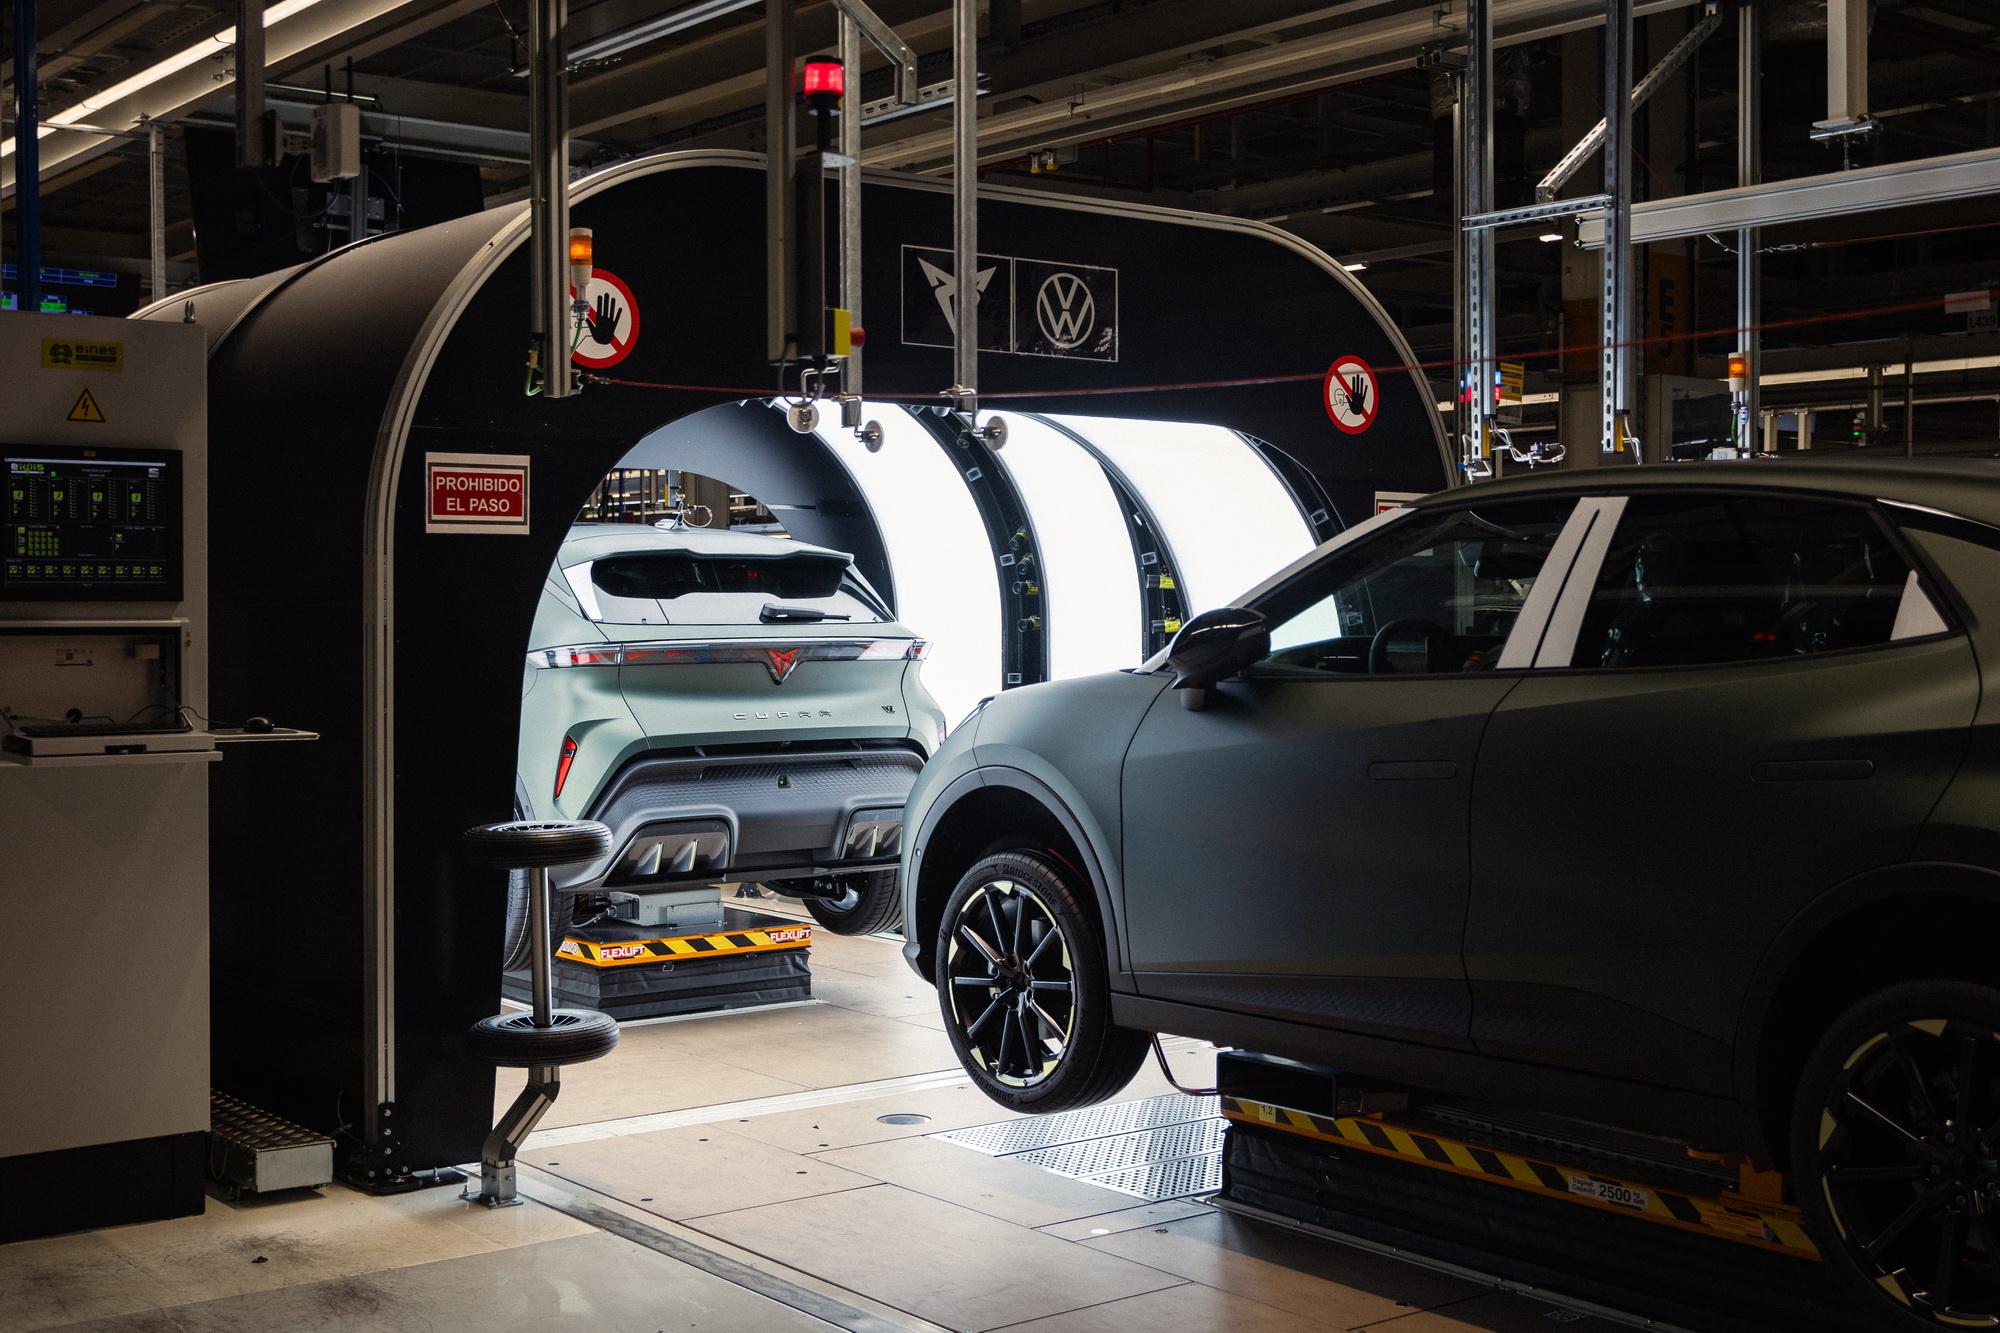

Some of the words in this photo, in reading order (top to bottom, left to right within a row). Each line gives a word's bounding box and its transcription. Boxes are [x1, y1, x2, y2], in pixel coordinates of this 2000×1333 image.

[75, 344, 117, 355] eines
[435, 476, 520, 493] PROHIBIDO
[446, 497, 465, 512] EL
[469, 498, 510, 513] PASO
[732, 709, 832, 721] CUPRA
[1003, 864, 1058, 907] BRIDGESTONE
[771, 929, 811, 942] FLEXLIFT
[601, 945, 645, 959] FLEXLIFT
[963, 1056, 1015, 1104] BRIDGESTONE
[1262, 1105, 1273, 1115] 1.2
[1572, 1184, 1596, 1195] Capacity
[1599, 1184, 1631, 1203] 2500
[1632, 1191, 1641, 1199] kg
